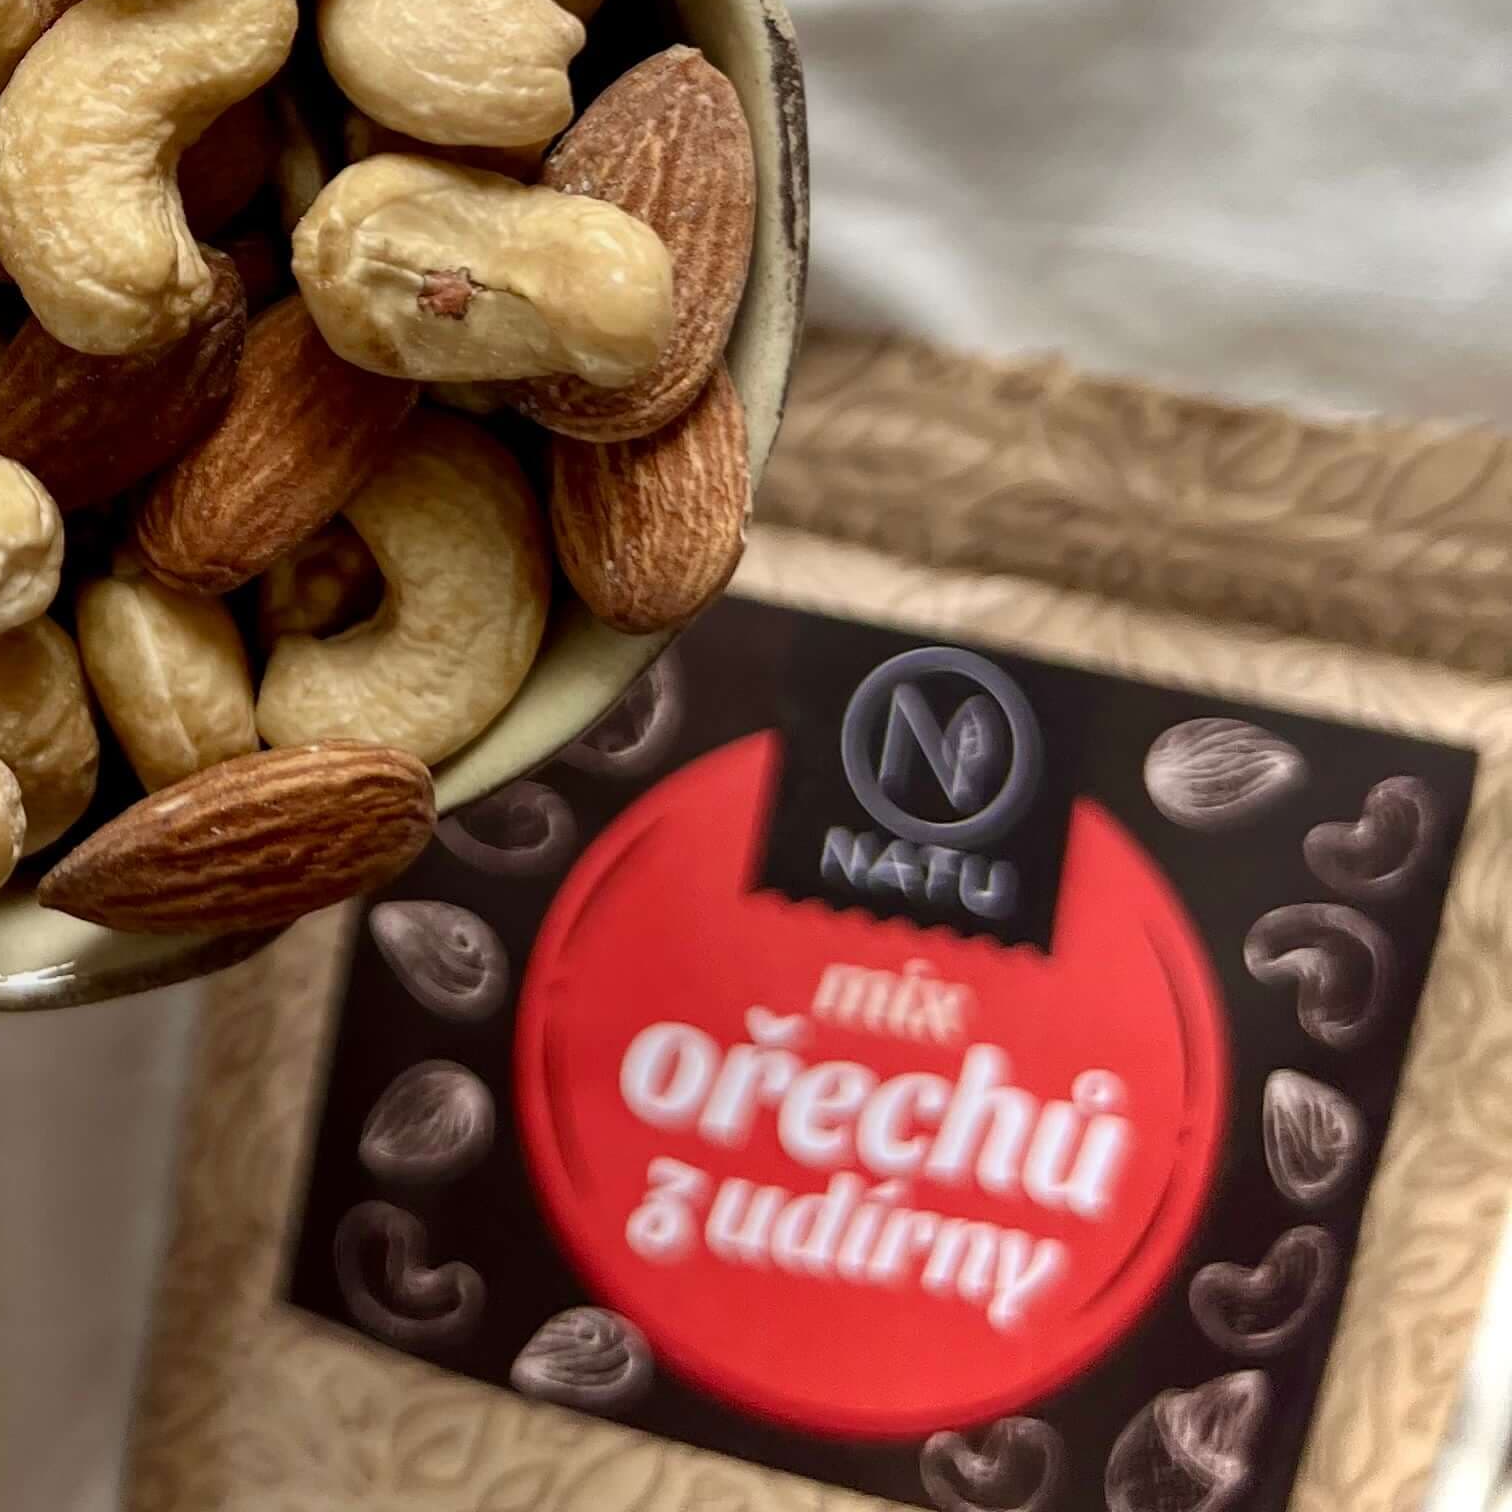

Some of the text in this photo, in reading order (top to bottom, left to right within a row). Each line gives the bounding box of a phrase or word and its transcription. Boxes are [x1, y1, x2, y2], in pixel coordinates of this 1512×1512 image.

[820, 825, 1018, 918] NATU
[811, 958, 972, 1042] mix
[619, 1005, 1132, 1220] ořechů
[625, 1156, 1068, 1331] z udírny
